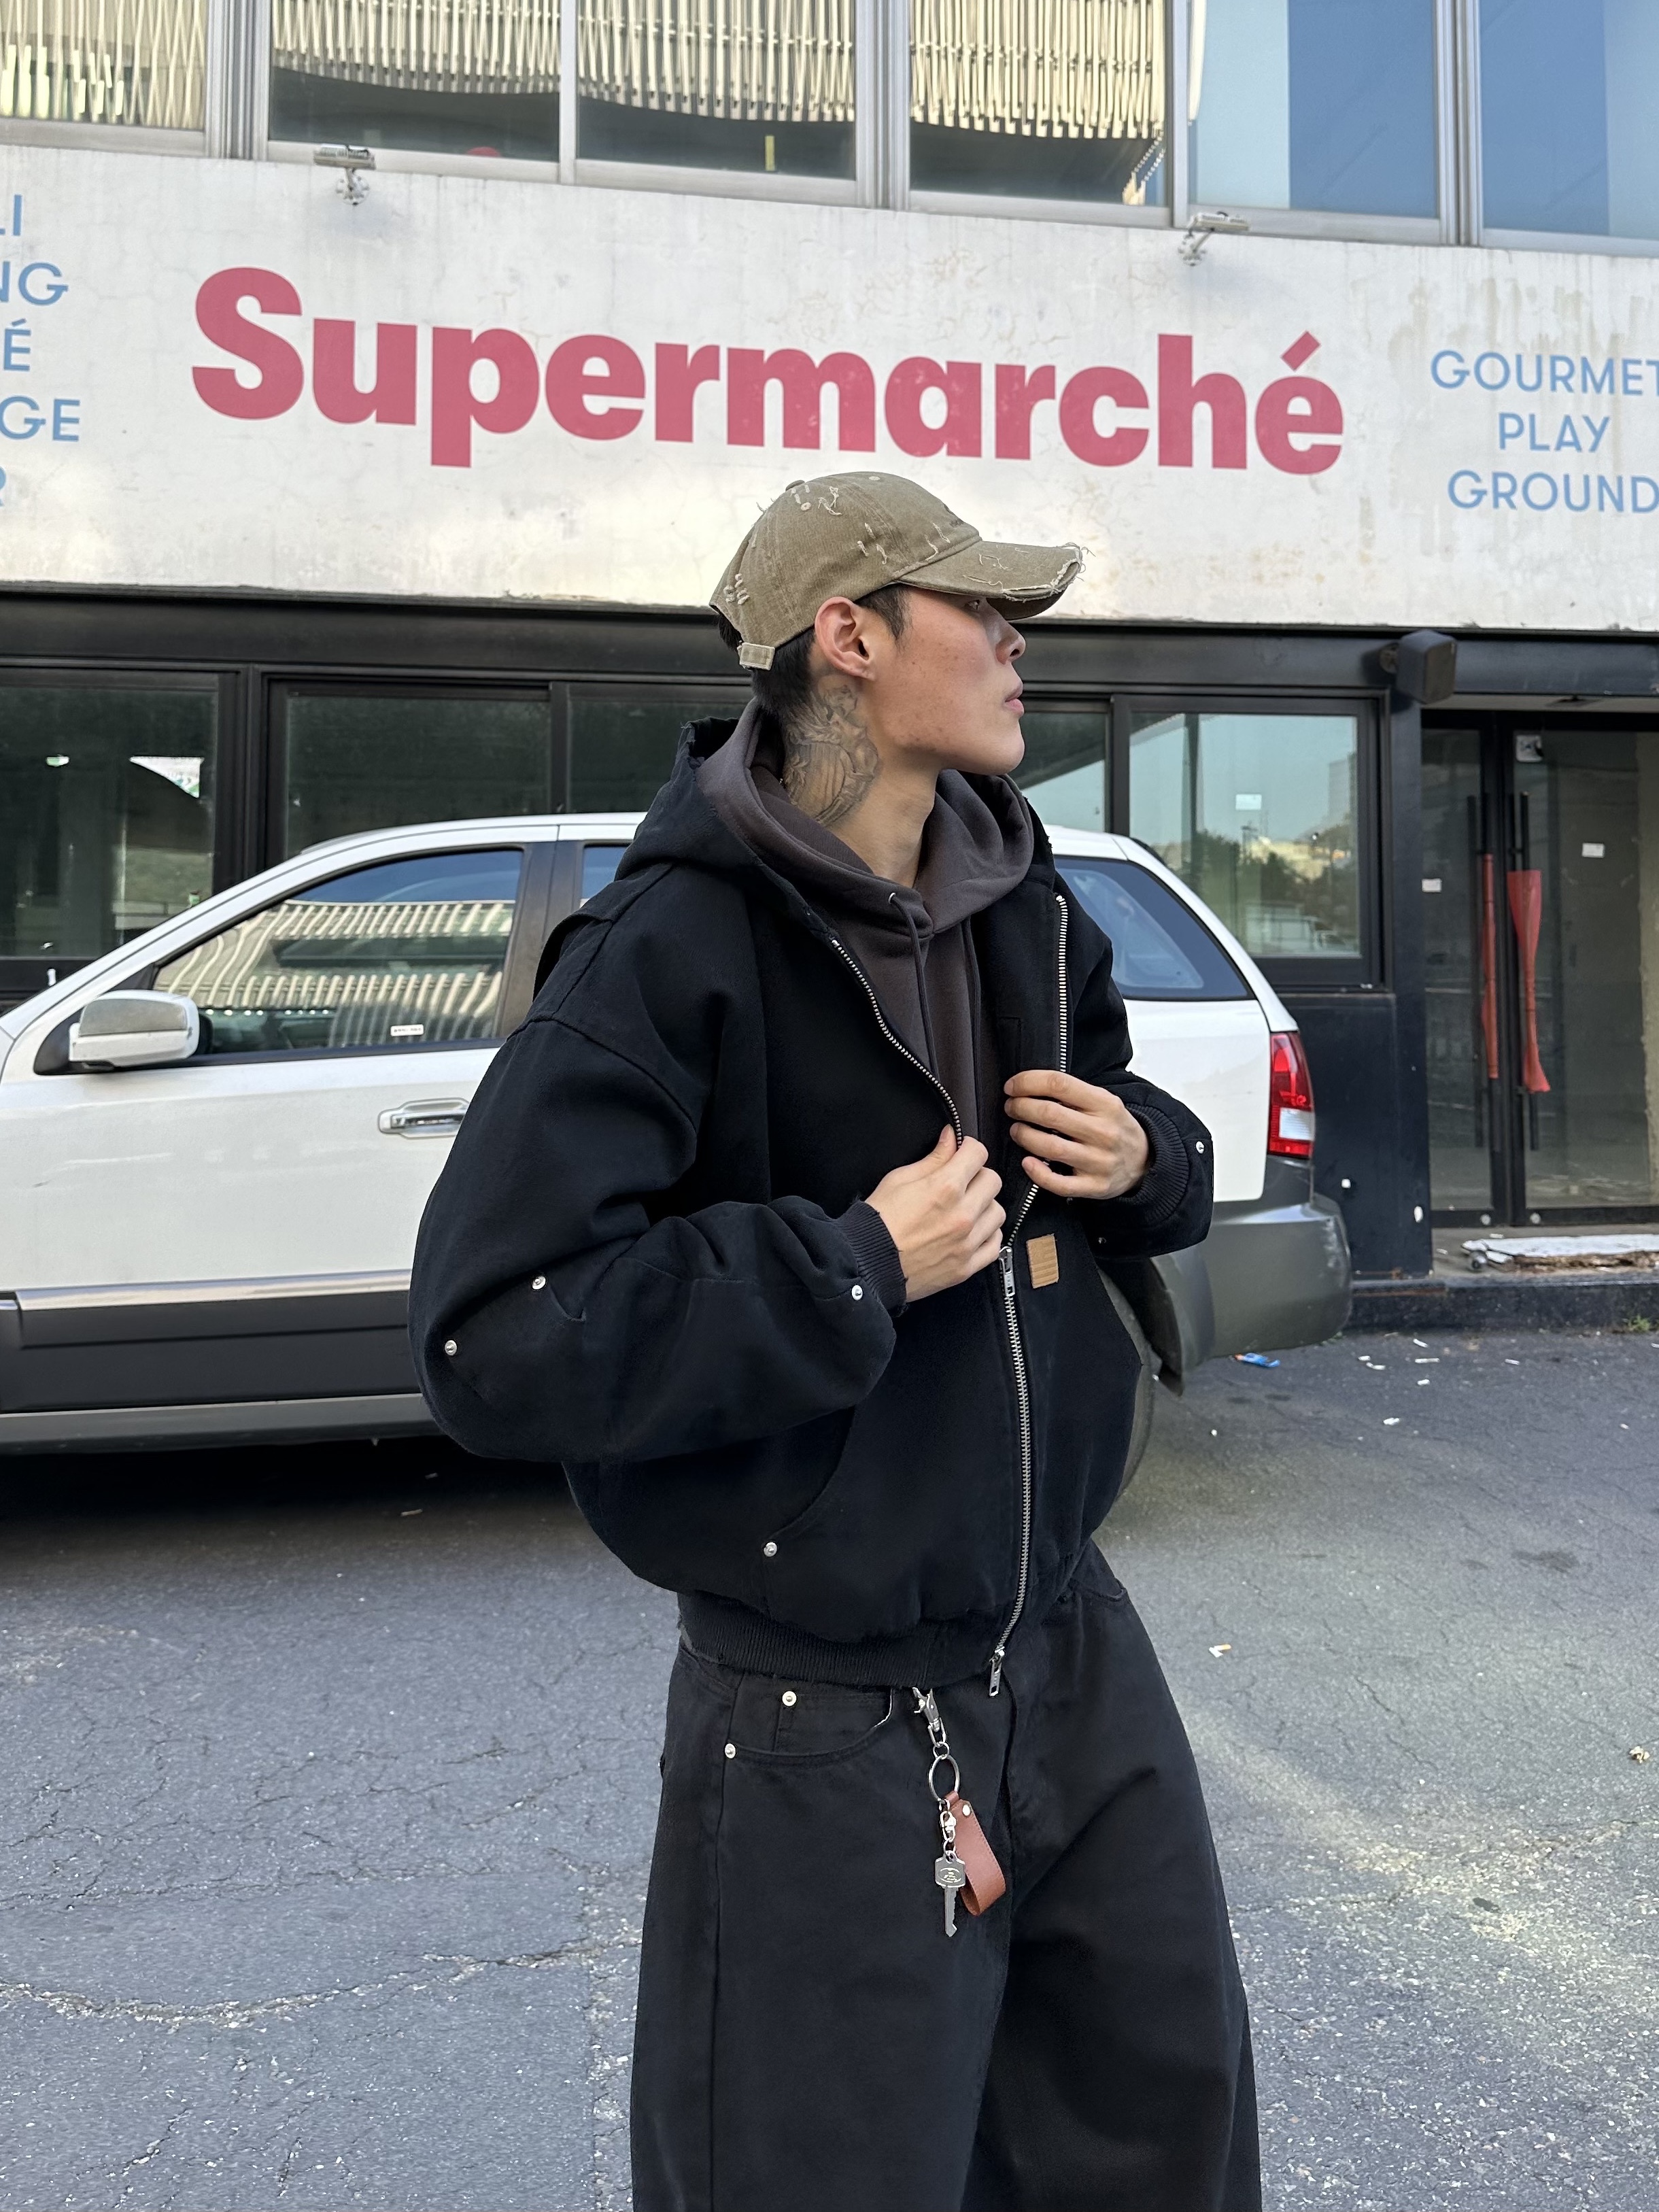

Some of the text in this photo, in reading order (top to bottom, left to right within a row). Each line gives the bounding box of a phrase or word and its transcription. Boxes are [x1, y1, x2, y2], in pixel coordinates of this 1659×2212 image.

[3, 319, 31, 372] É
[192, 266, 1345, 475] Supermarché
[1498, 412, 1610, 453] PLAY
[1448, 469, 1659, 514] GROUND
